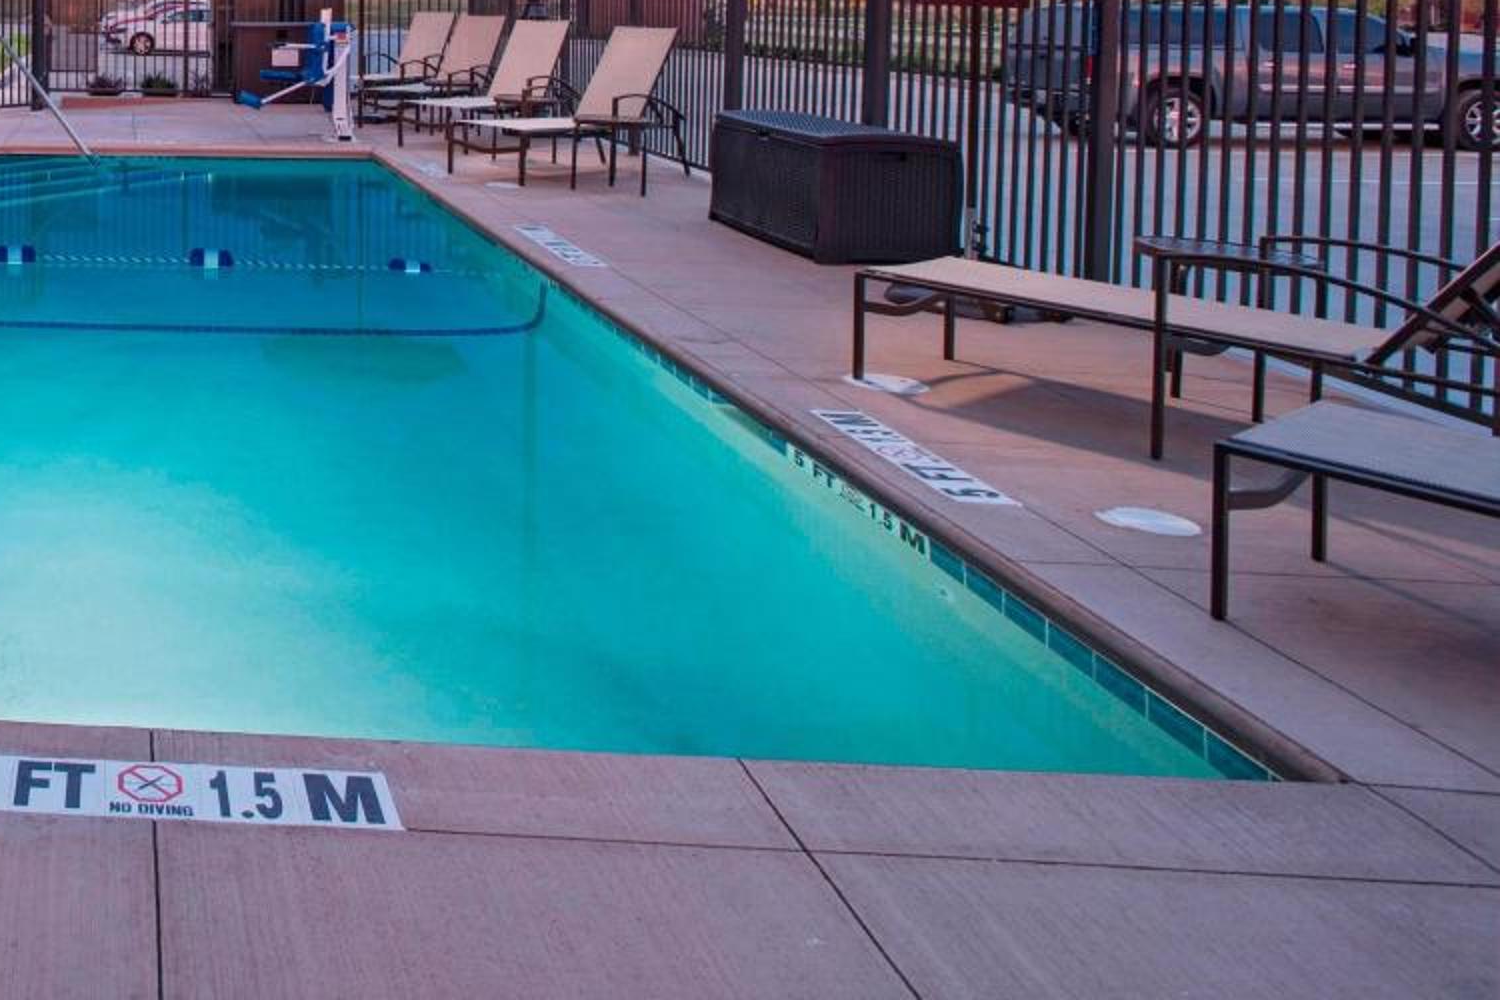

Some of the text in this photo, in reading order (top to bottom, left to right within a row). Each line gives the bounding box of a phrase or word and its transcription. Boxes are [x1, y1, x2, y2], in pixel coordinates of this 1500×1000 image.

[900, 521, 926, 555] M
[13, 760, 95, 809] FT
[209, 771, 283, 819] 1.5
[303, 773, 387, 824] M
[109, 801, 194, 817] NO DIVING
